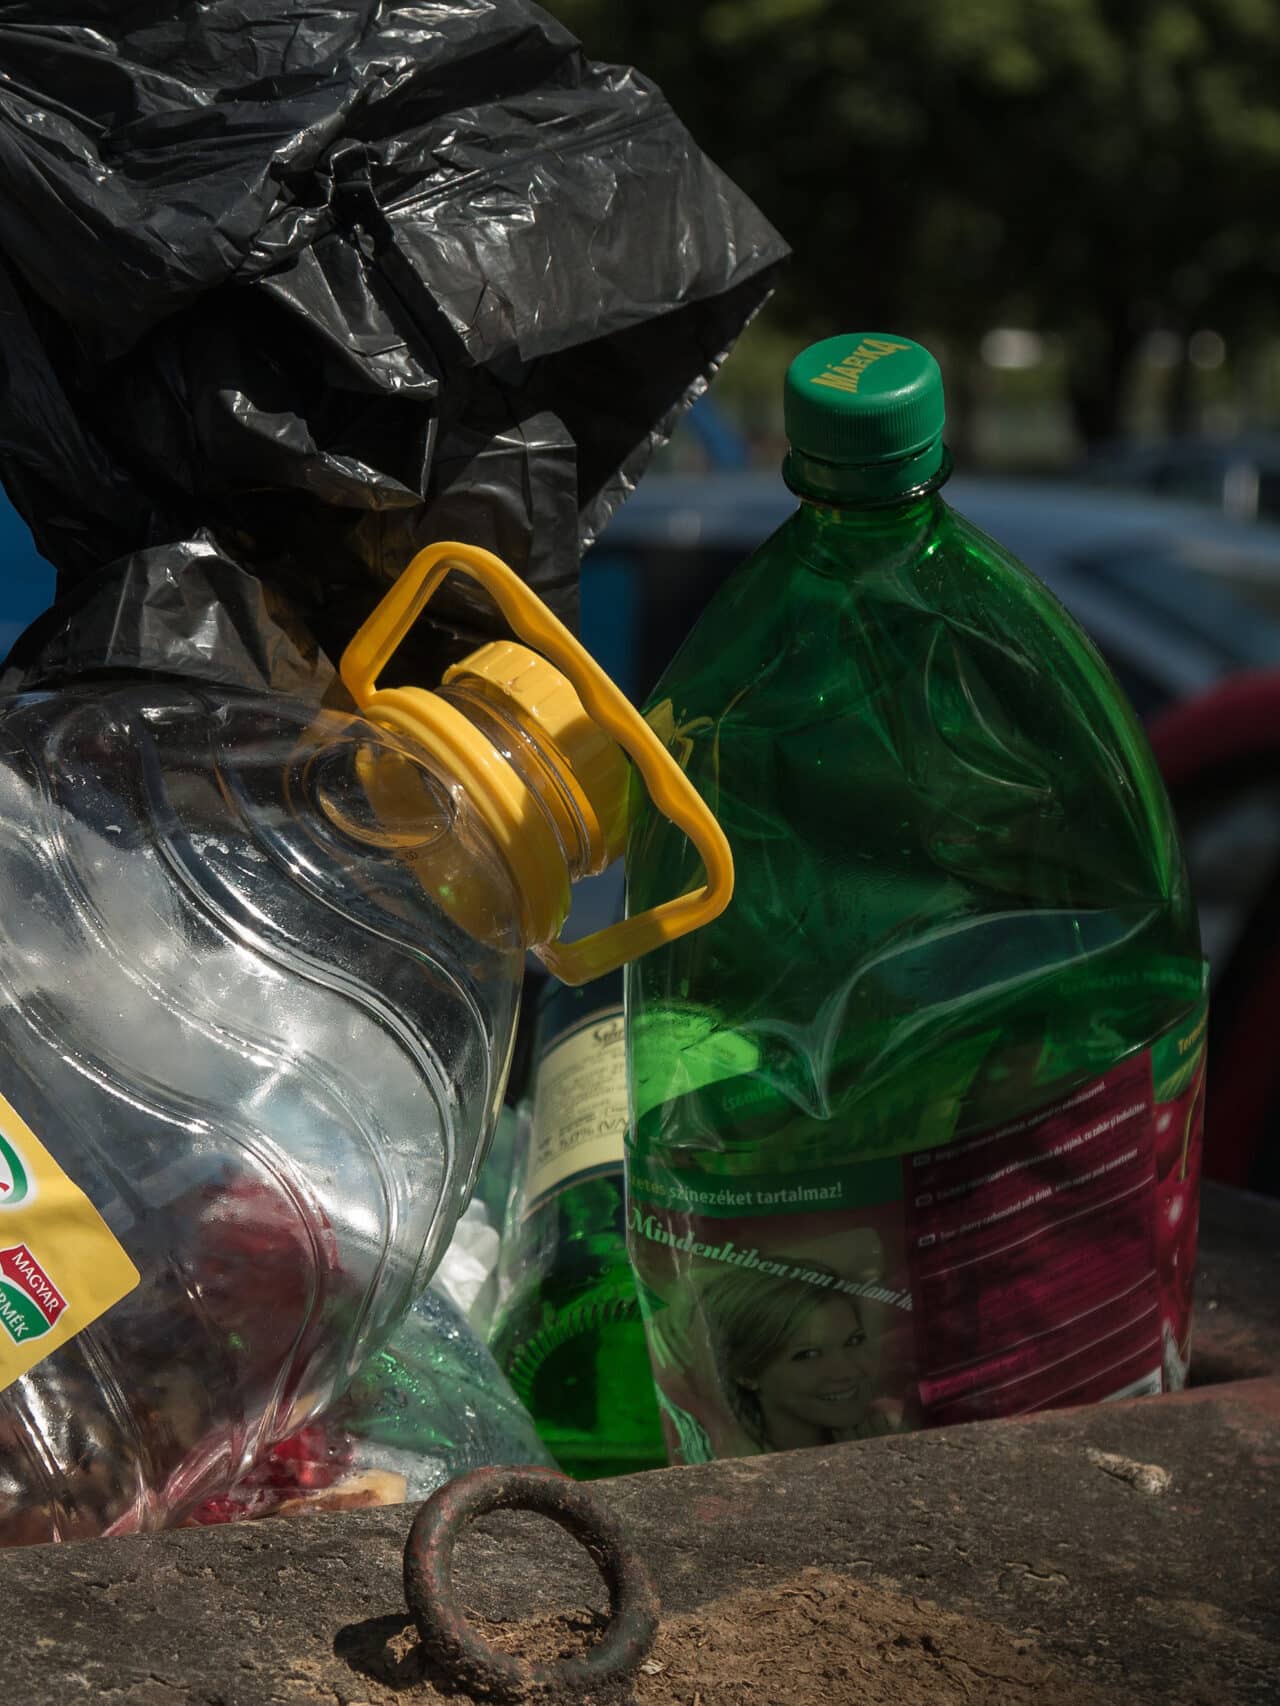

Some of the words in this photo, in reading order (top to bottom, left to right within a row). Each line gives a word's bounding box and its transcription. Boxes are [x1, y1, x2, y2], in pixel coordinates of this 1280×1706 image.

[756, 1181, 842, 1205] tartalmaz!
[628, 1207, 787, 1276] Mindenkiben
[10, 1251, 59, 1312] MAGYAR
